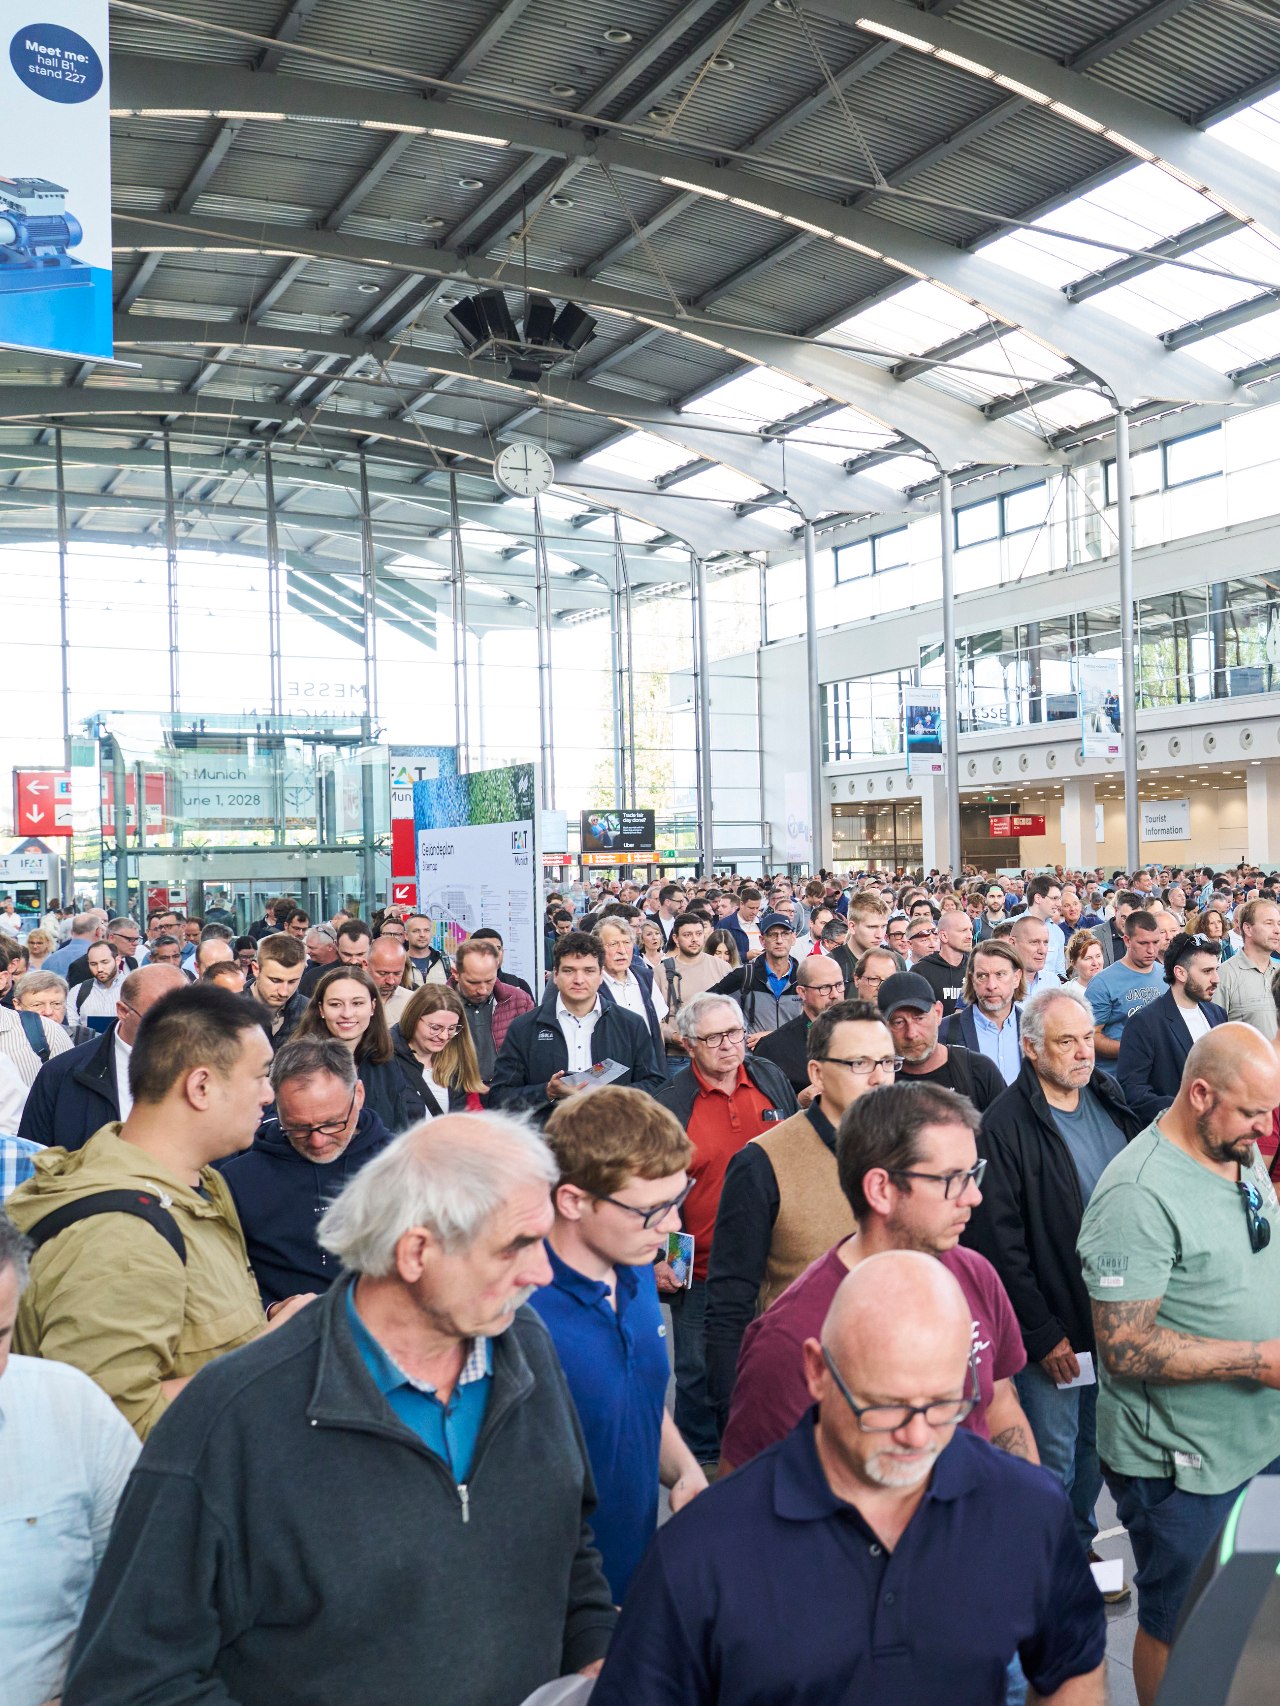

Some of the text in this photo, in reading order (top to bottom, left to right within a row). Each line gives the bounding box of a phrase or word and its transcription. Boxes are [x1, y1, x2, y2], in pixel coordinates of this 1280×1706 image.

[25, 40, 89, 64] Meet me:
[37, 54, 77, 73] hall B1,
[28, 64, 87, 84] stand 227
[183, 794, 211, 806] une
[227, 794, 261, 806] 2028
[1144, 814, 1167, 824] Tourist
[1145, 825, 1183, 836] Information
